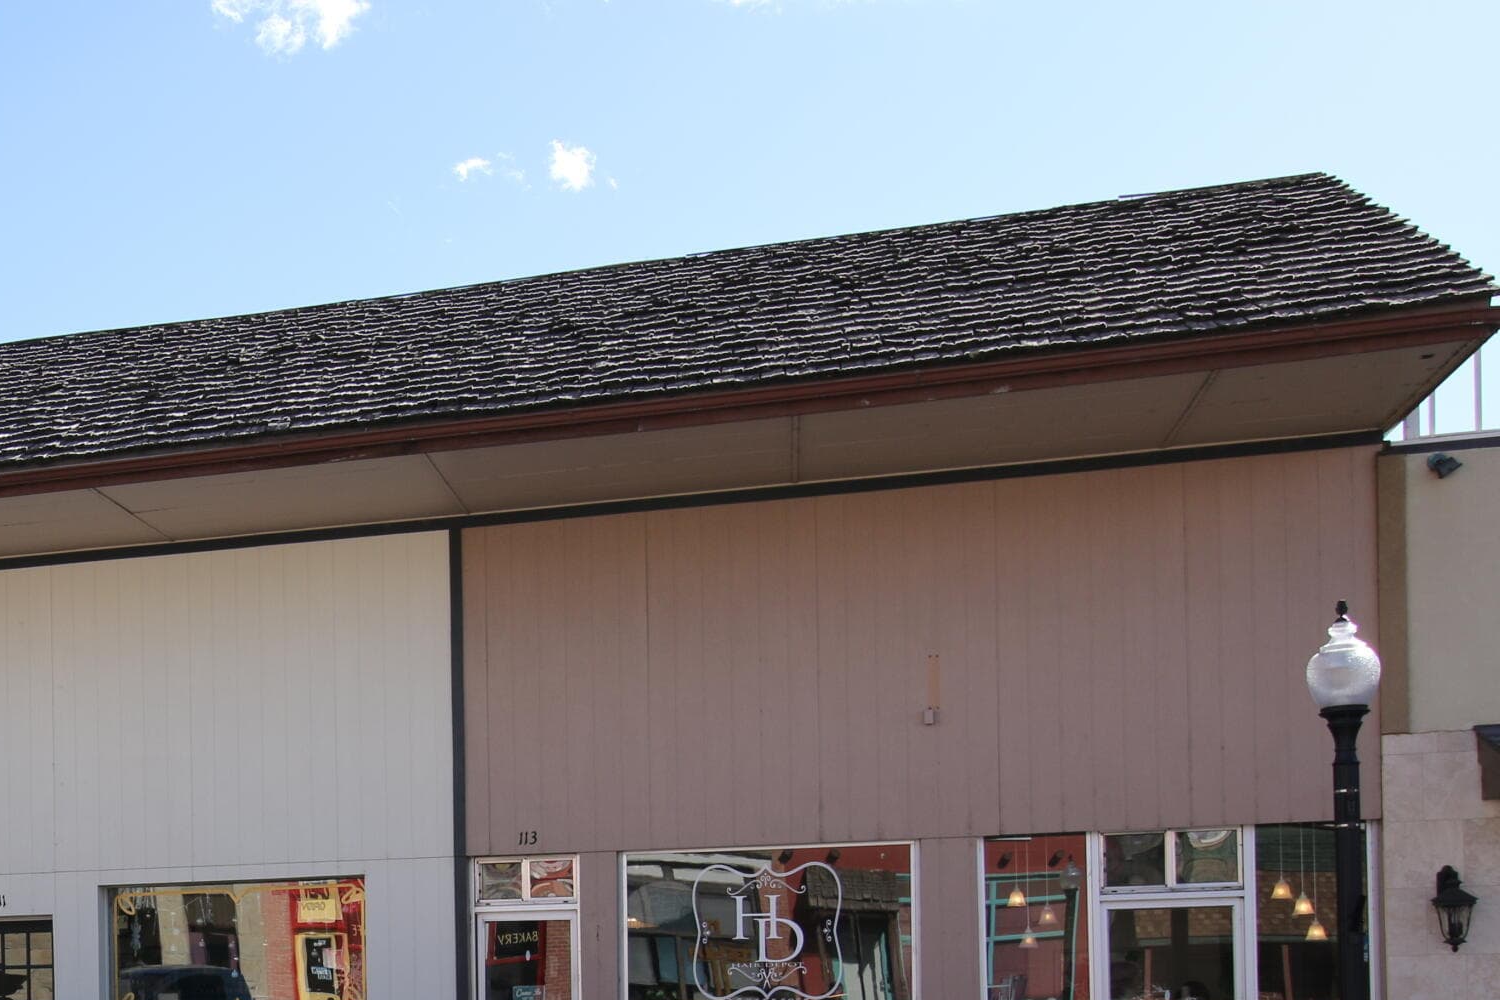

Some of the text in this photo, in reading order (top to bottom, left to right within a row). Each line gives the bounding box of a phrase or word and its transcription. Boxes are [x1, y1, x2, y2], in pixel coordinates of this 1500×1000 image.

[519, 831, 538, 846] 113
[731, 961, 805, 969] HAIR DEPOT
